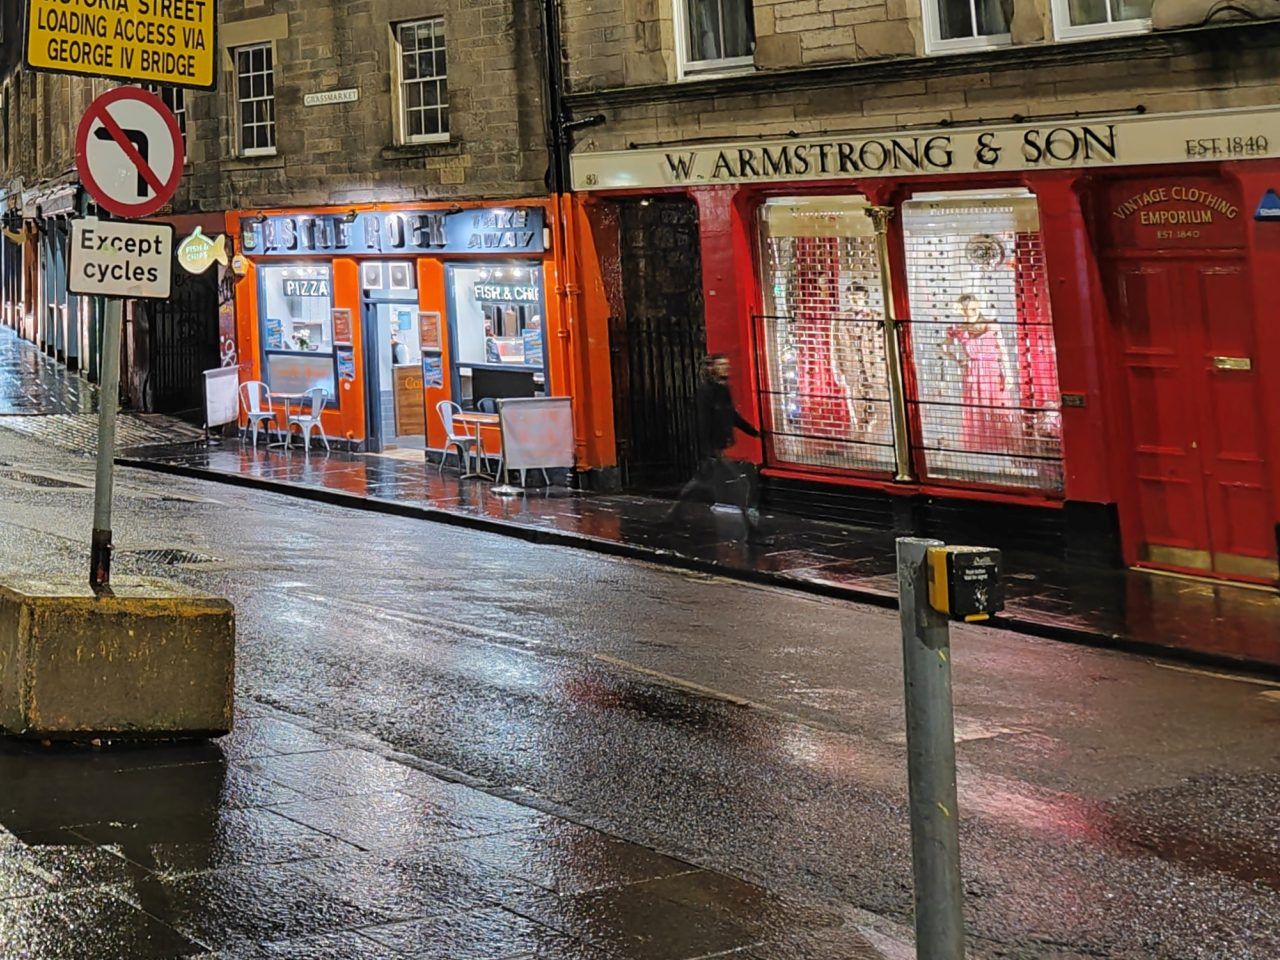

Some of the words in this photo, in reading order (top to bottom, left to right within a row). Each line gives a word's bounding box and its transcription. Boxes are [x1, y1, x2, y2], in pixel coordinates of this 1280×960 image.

[38, 7, 107, 38] LOADING
[114, 17, 176, 47] ACCESS
[182, 26, 206, 51] VIA
[48, 38, 114, 68] GEORGE
[120, 46, 134, 70] IV
[141, 50, 196, 77] BRIDGE
[305, 90, 357, 105] GRASSMARKET
[711, 135, 954, 179] ARMSTRONG
[975, 132, 1002, 166] &
[1023, 125, 1118, 164] SON
[1226, 134, 1269, 155] 1840
[1113, 187, 1169, 220] VINTAGE
[1171, 186, 1239, 220] CLOTHING
[472, 209, 528, 229] TAKE
[1140, 209, 1213, 225] EMPORIUM
[363, 213, 447, 251] ROCK
[469, 231, 534, 249] AWAY
[1177, 230, 1200, 238] 1840
[81, 229, 163, 257] Except
[83, 260, 158, 283] cycles
[287, 280, 328, 296] PIZZA
[474, 285, 501, 300] FISH
[503, 286, 512, 300] &
